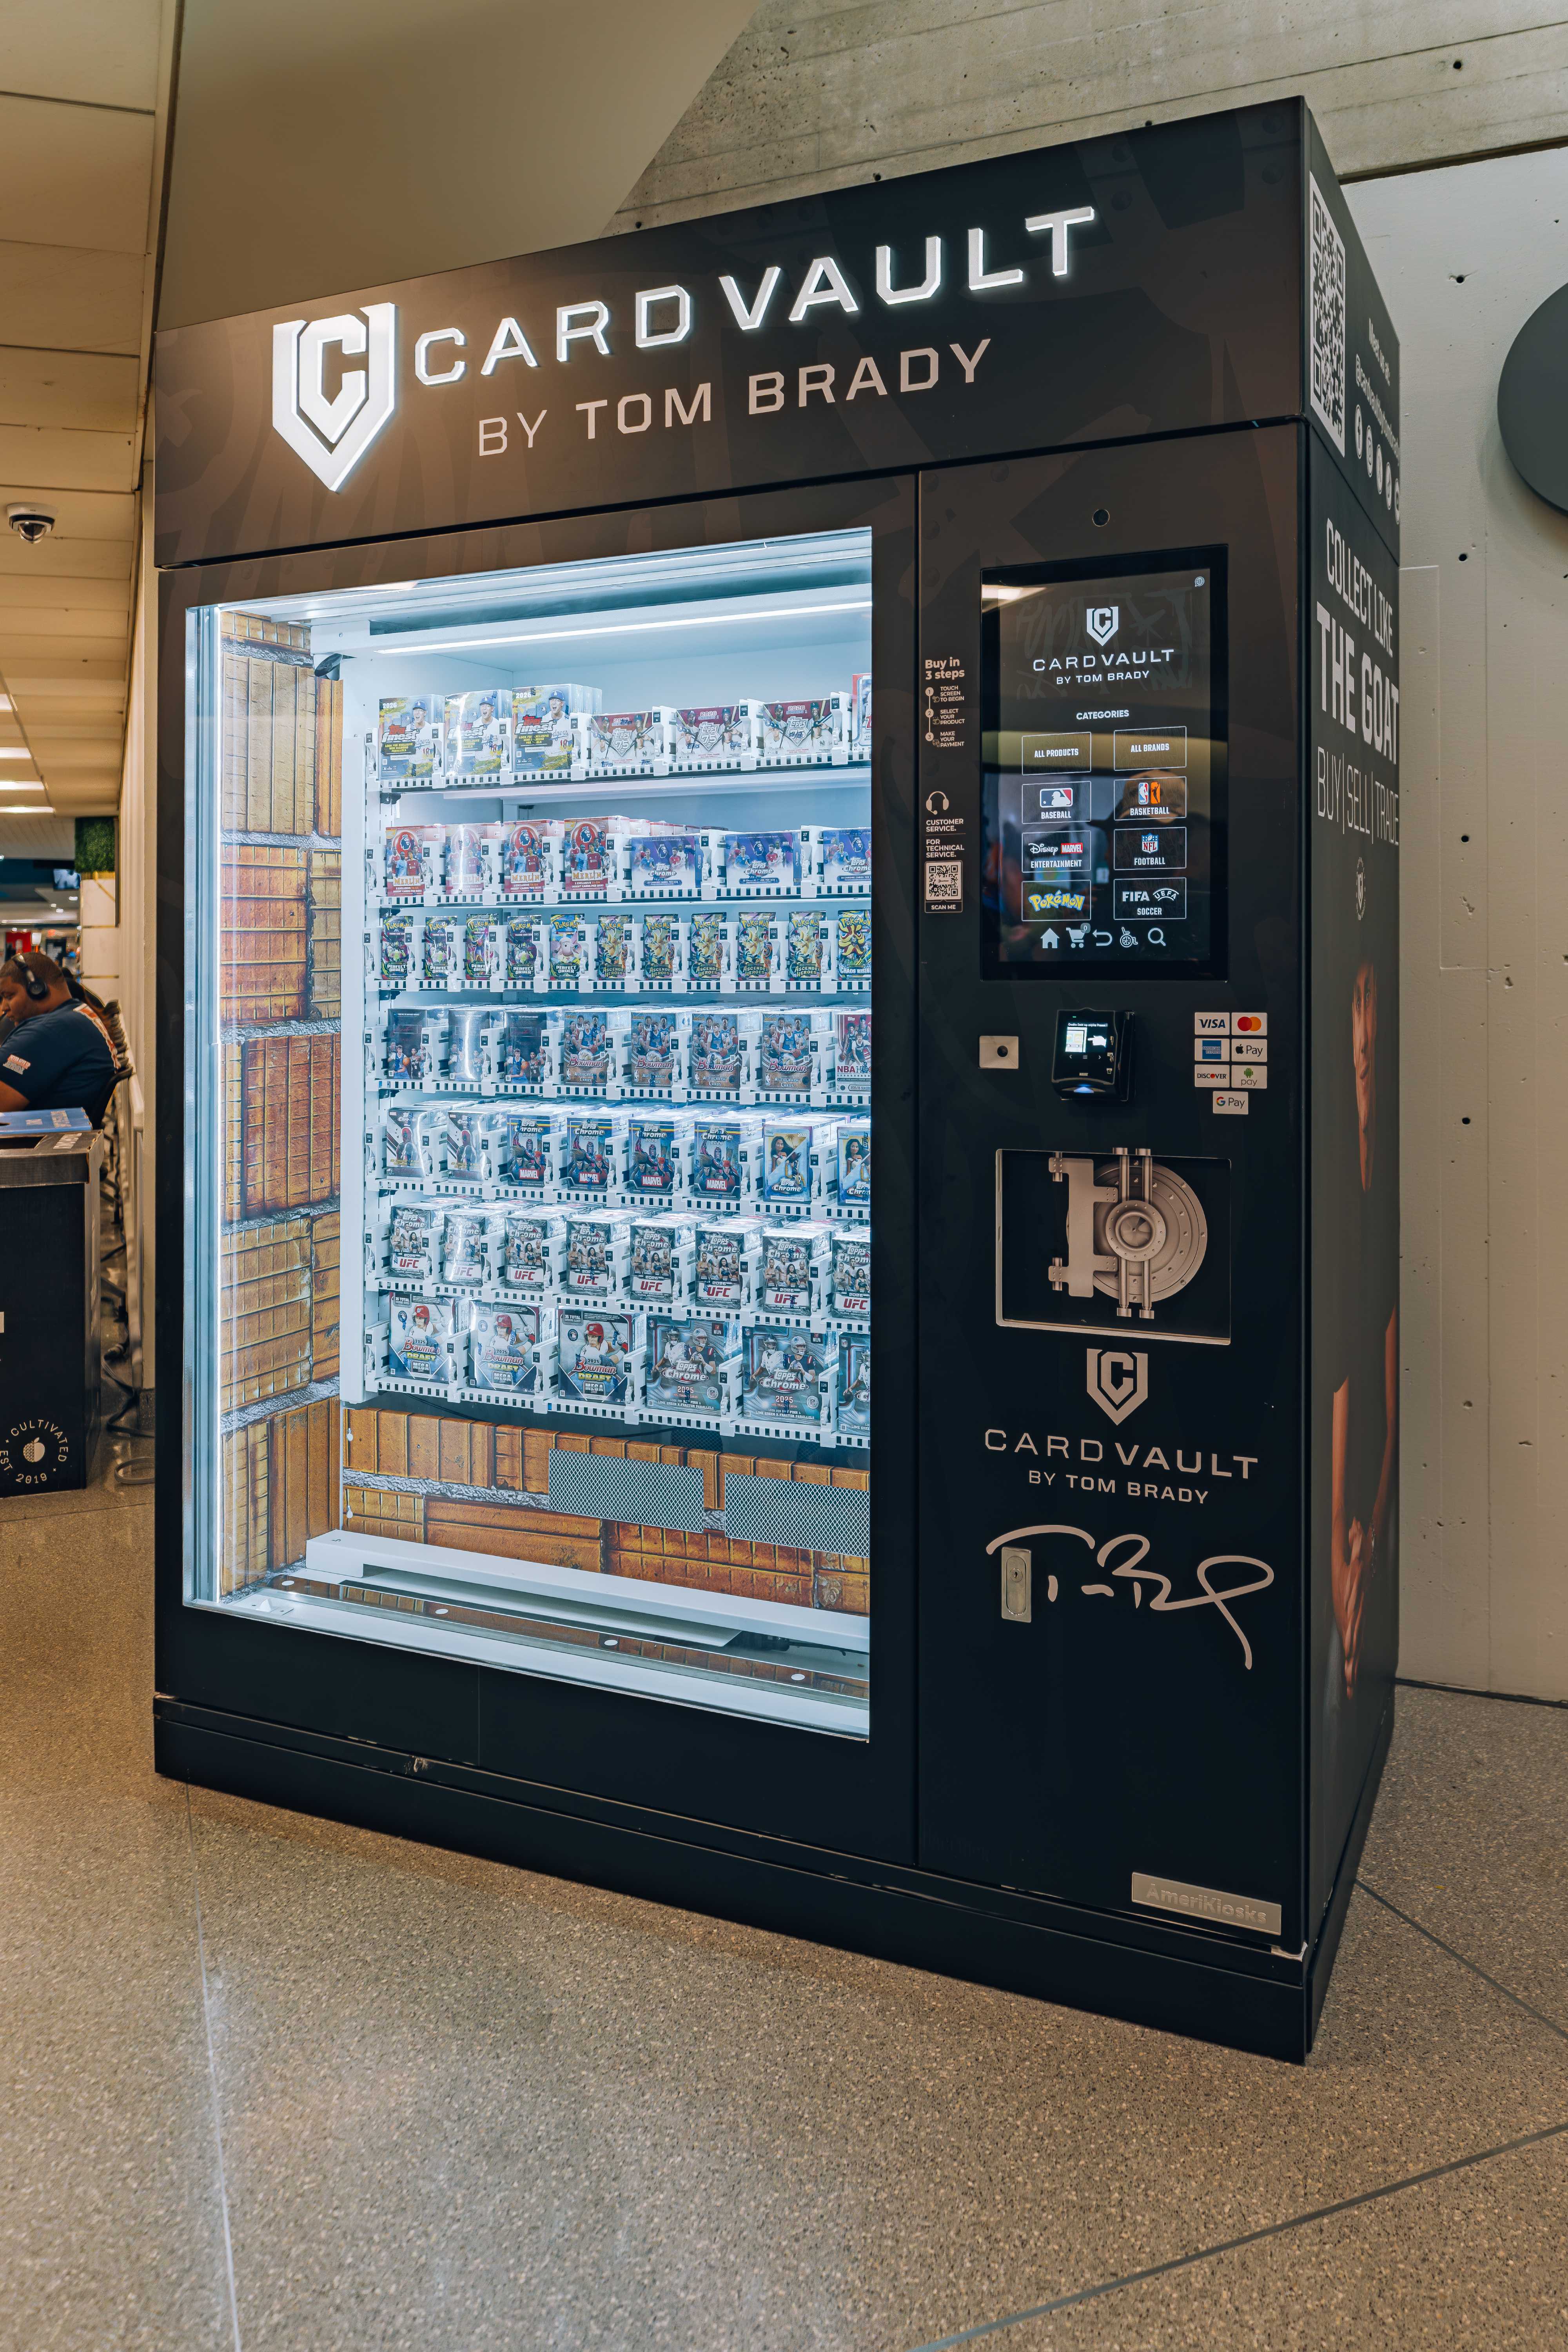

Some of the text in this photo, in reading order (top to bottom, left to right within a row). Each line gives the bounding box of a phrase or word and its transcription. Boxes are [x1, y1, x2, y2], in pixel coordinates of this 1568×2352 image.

[478, 338, 992, 457] BY TOM BRADY
[1327, 518, 1393, 658] COLLECT LIKE
[926, 657, 960, 669] Buy in
[926, 670, 965, 680] 3 steps
[1057, 671, 1149, 684] BY TOM BRADY
[1317, 601, 1399, 765] THE GOAT
[1076, 710, 1129, 720] CATEGORIES
[515, 721, 557, 734] finest
[1046, 748, 1079, 757] PRODUCTS
[1143, 743, 1169, 752] BRANDS
[1318, 746, 1399, 846] BUY SELL TRADE
[1041, 811, 1071, 819] BASEBALL
[1130, 806, 1169, 816] BASKETBALL
[1028, 843, 1082, 856] Disney MARVEL
[1143, 842, 1157, 852] NFL
[1031, 859, 1082, 868] ENTERTAINMENT
[1134, 857, 1165, 865] FOOTBALL
[512, 873, 540, 882] MERLIN
[573, 871, 602, 880] MERLIN
[1122, 890, 1176, 902] FIFA UEFA
[1137, 907, 1162, 915] SOCCER
[1198, 1019, 1226, 1028] VISA
[1246, 1045, 1263, 1057] Pay
[568, 1054, 604, 1067] Bowman
[766, 1058, 808, 1073] Bowman
[1216, 1096, 1245, 1109] G Pay
[520, 1170, 538, 1178] MARVEL
[642, 1176, 662, 1185] MARVEL
[707, 1180, 726, 1189] MARVEL
[515, 1270, 535, 1280] UFC
[641, 1281, 662, 1291] UFC
[708, 1287, 731, 1297] UFC
[483, 1346, 524, 1365] Bowman
[488, 1363, 519, 1372] DRAFT
[573, 1356, 616, 1374] Bowman
[676, 1361, 697, 1372] Topps
[578, 1373, 612, 1382] DRAFT
[665, 1368, 706, 1381] Chrome
[585, 1383, 603, 1392] MEGA
[11, 1419, 68, 1462] CULTIVATED
[0, 1450, 13, 1470] EST
[16, 1473, 47, 1484] 2019
[1029, 1470, 1208, 1504] BY TOM BRADY
[1146, 1883, 1267, 1924] AmeriKiosks
